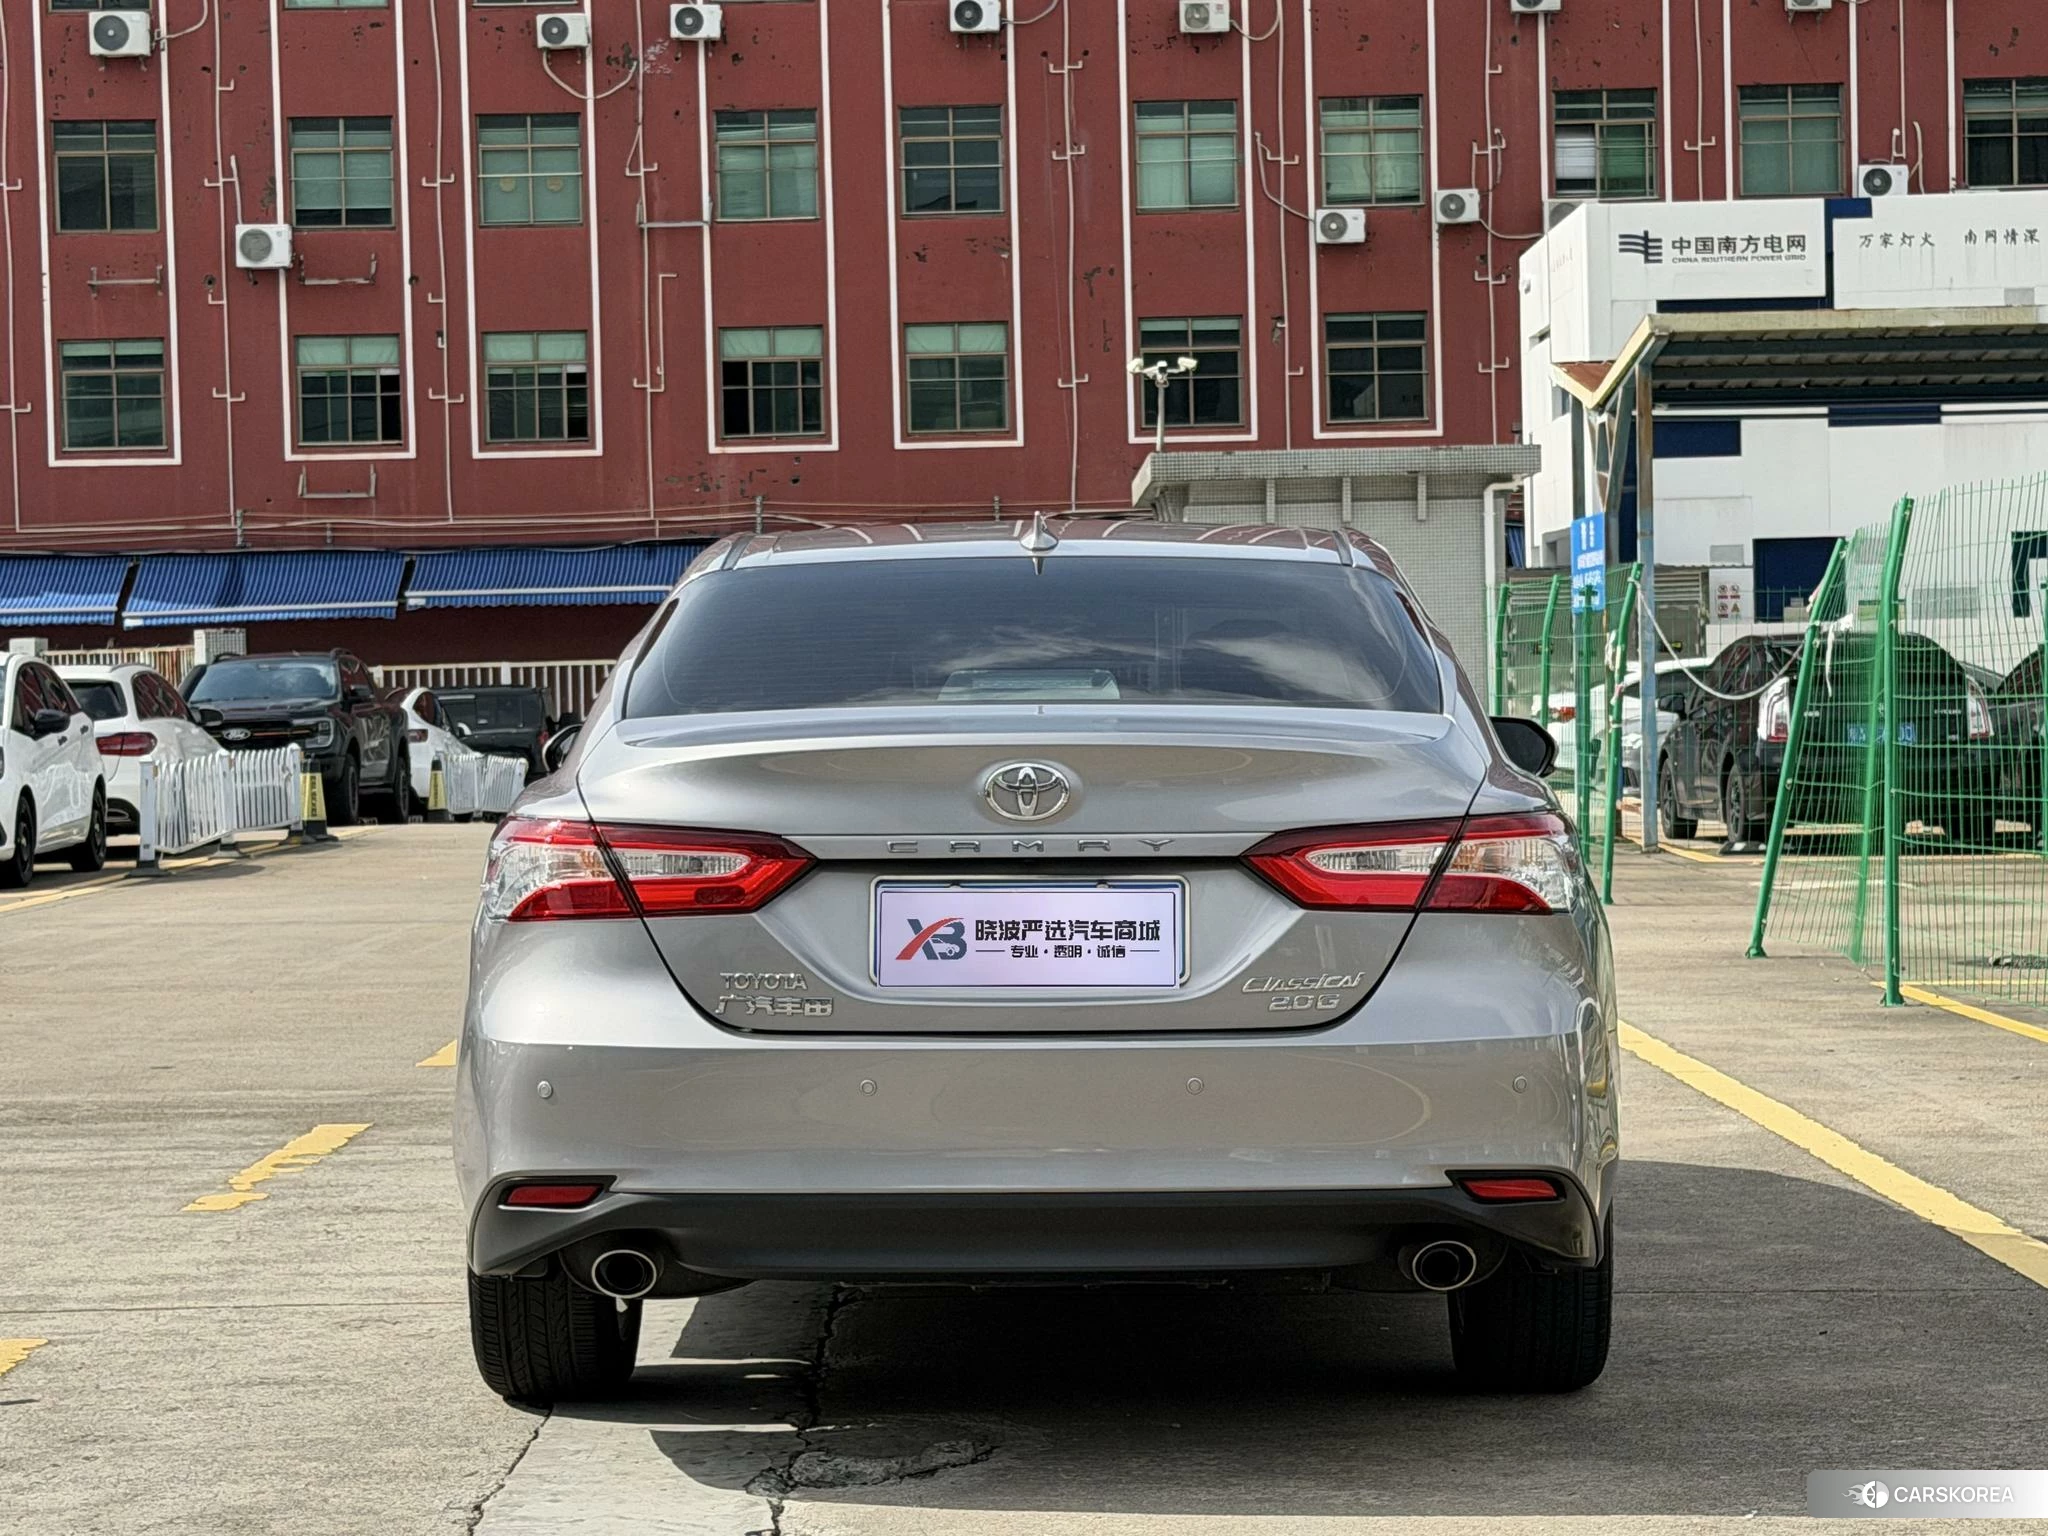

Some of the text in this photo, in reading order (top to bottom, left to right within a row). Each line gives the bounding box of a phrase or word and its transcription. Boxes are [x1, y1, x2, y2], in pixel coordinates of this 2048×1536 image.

[1671, 234, 1806, 255] 中国南方电网
[1859, 228, 2041, 249] 万家灯火 南网情深
[887, 839, 1175, 855] CAMRY
[975, 919, 1160, 941] 晓波严选汽车商城
[719, 972, 808, 990] TOYOTA
[715, 994, 833, 1017] 广汽丰田
[1268, 993, 1340, 1012] 2.0G
